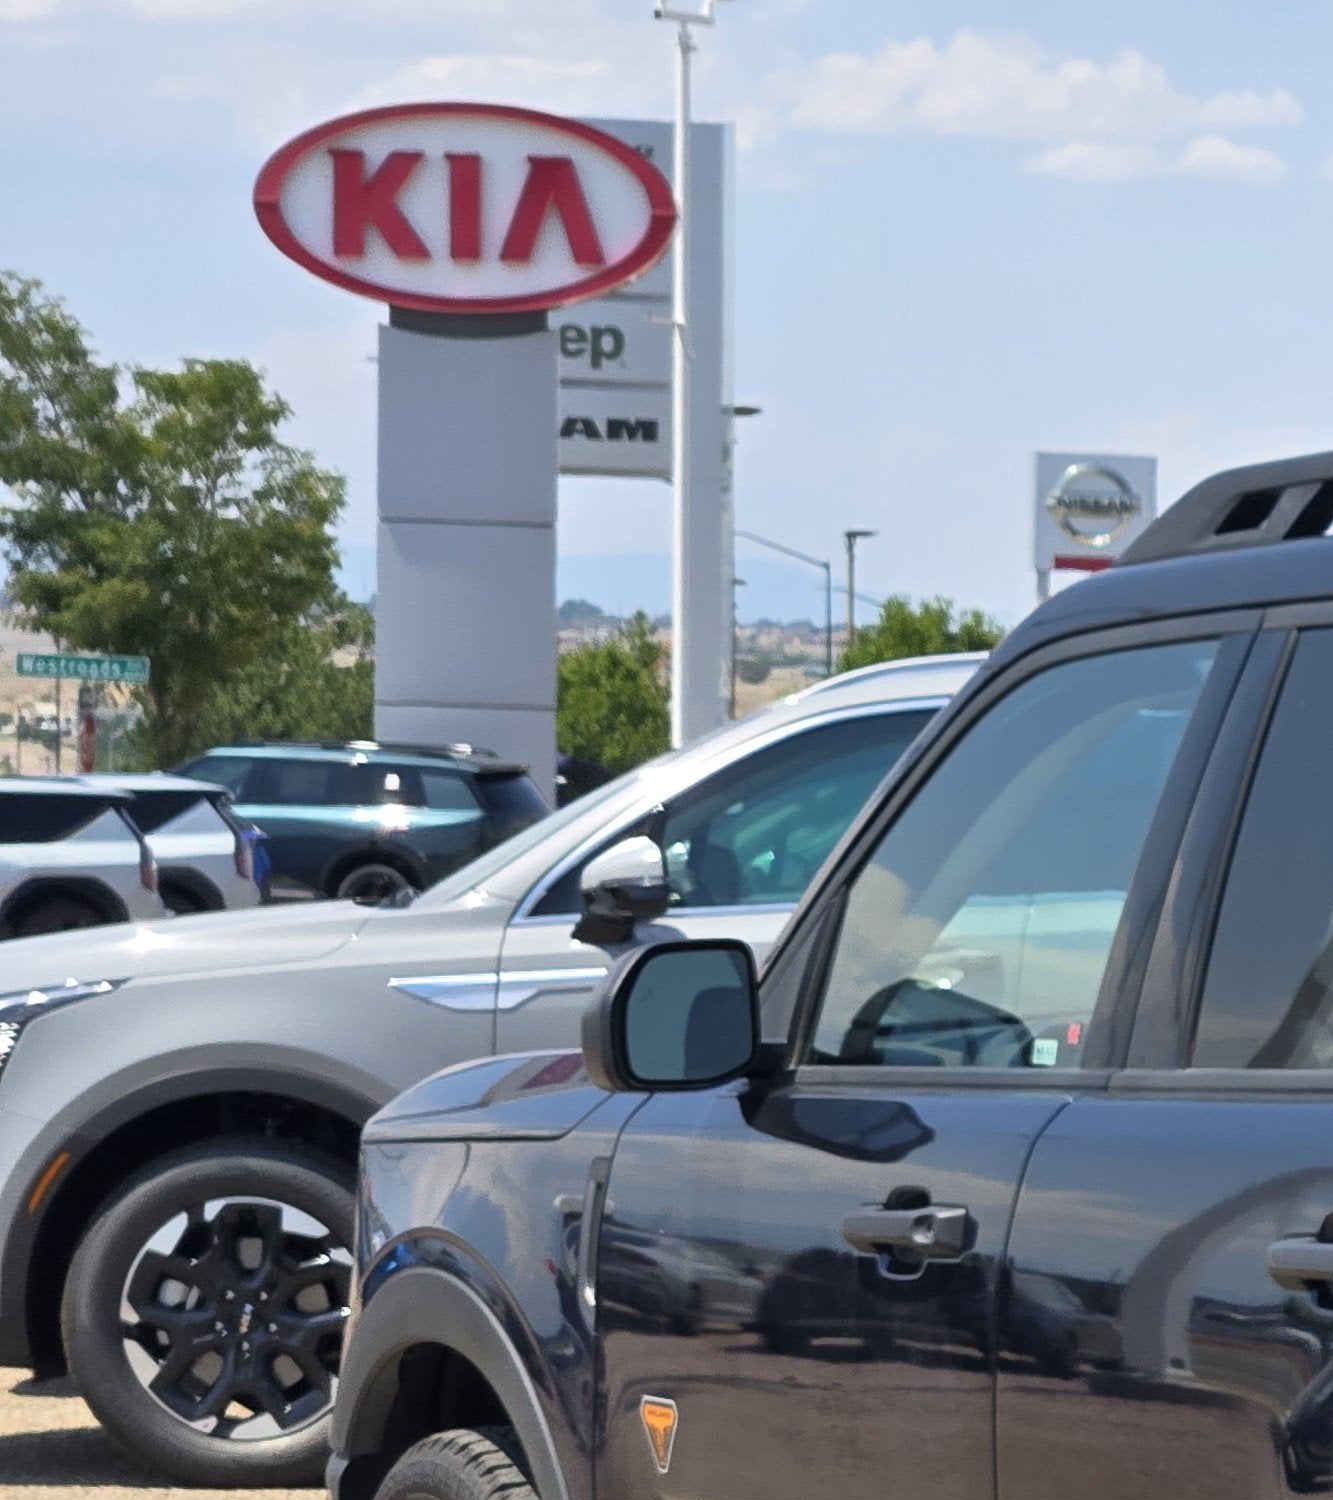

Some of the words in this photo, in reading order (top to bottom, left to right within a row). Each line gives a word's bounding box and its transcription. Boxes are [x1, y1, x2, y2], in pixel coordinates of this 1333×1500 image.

[328, 147, 607, 269] KIA
[558, 322, 626, 369] ep
[558, 415, 660, 443] AM
